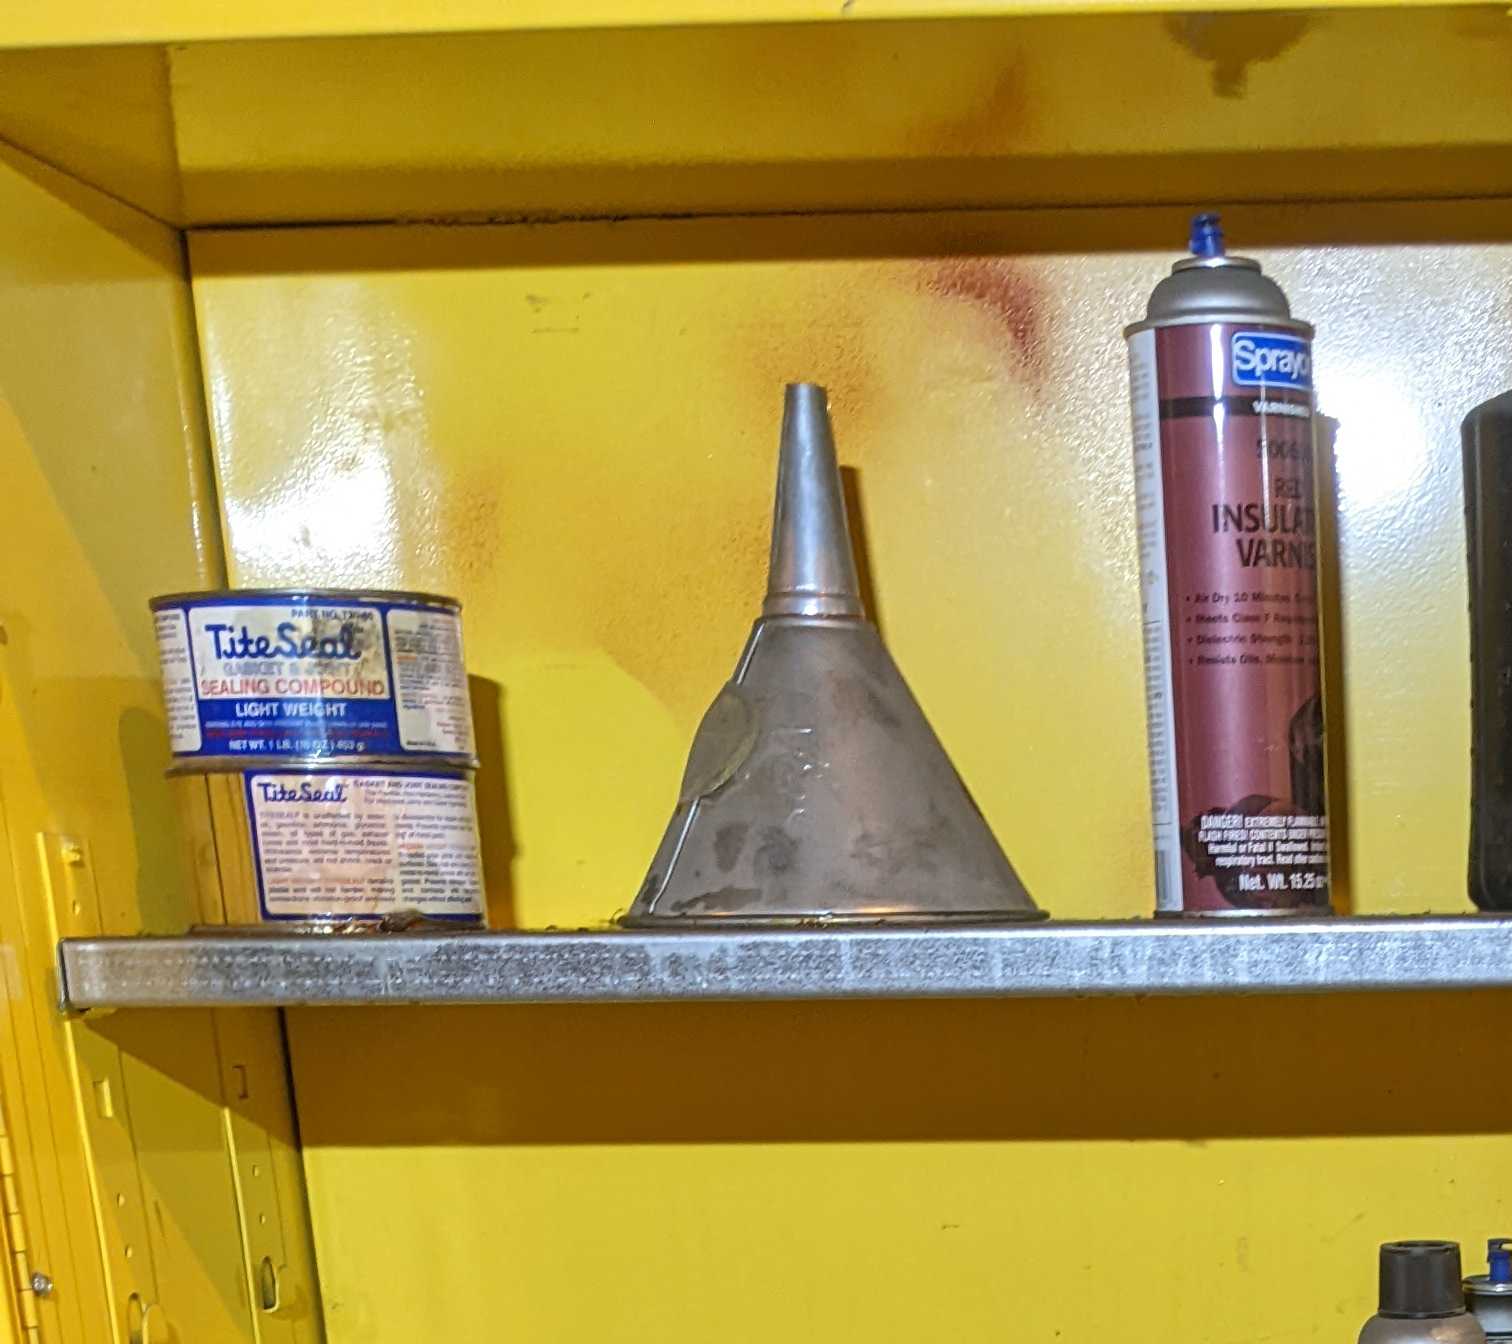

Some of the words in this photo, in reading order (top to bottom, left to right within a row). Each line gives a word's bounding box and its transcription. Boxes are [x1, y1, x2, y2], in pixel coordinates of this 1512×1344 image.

[204, 621, 362, 660] TiteSeal
[200, 678, 271, 696] SEALING
[275, 679, 385, 696] COMPOUND
[235, 702, 278, 717] LIGHT
[282, 702, 348, 717] WEIGHT
